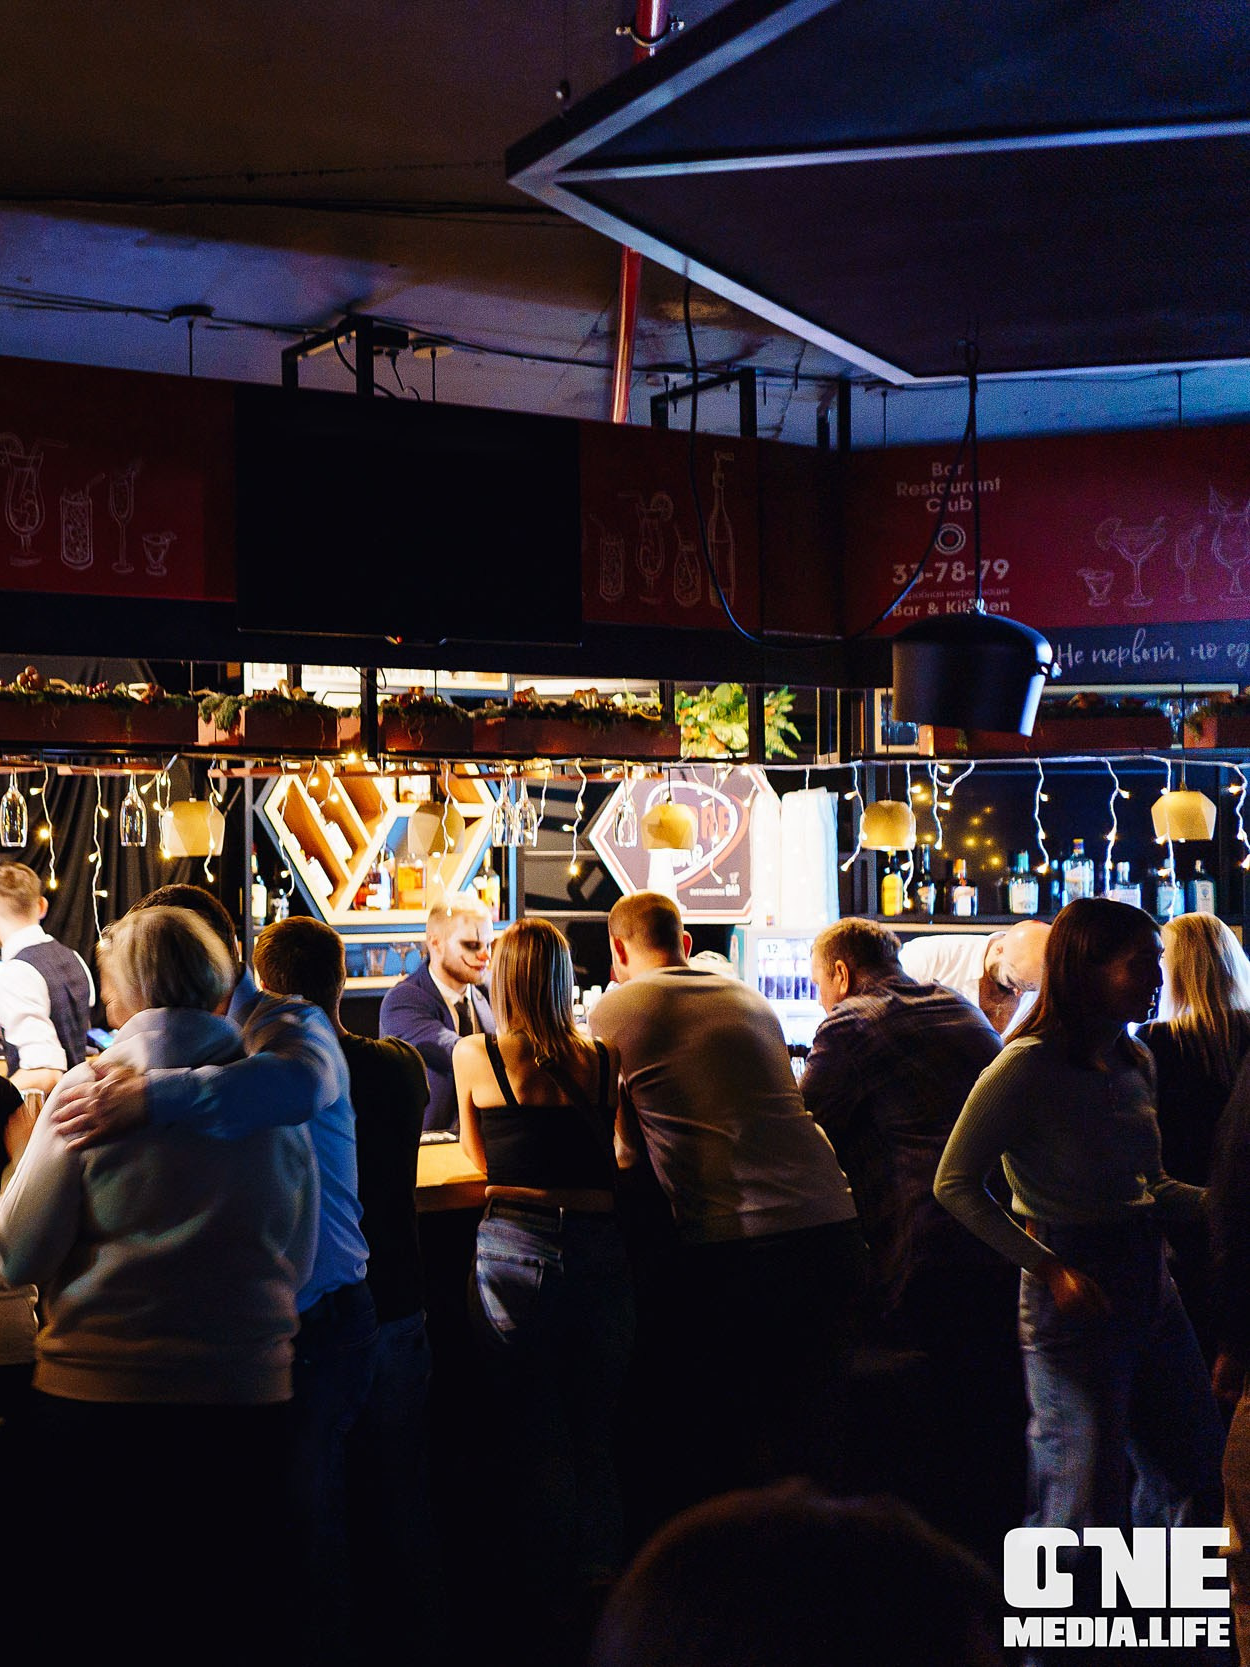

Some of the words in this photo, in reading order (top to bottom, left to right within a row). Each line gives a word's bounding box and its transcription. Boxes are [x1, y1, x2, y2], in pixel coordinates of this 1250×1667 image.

[926, 495, 973, 513] Cub
[892, 557, 1010, 586] 33-78-79
[927, 600, 939, 616] &
[946, 597, 1010, 614] Kiten
[1057, 642, 1084, 669] Не
[1190, 642, 1220, 661] но
